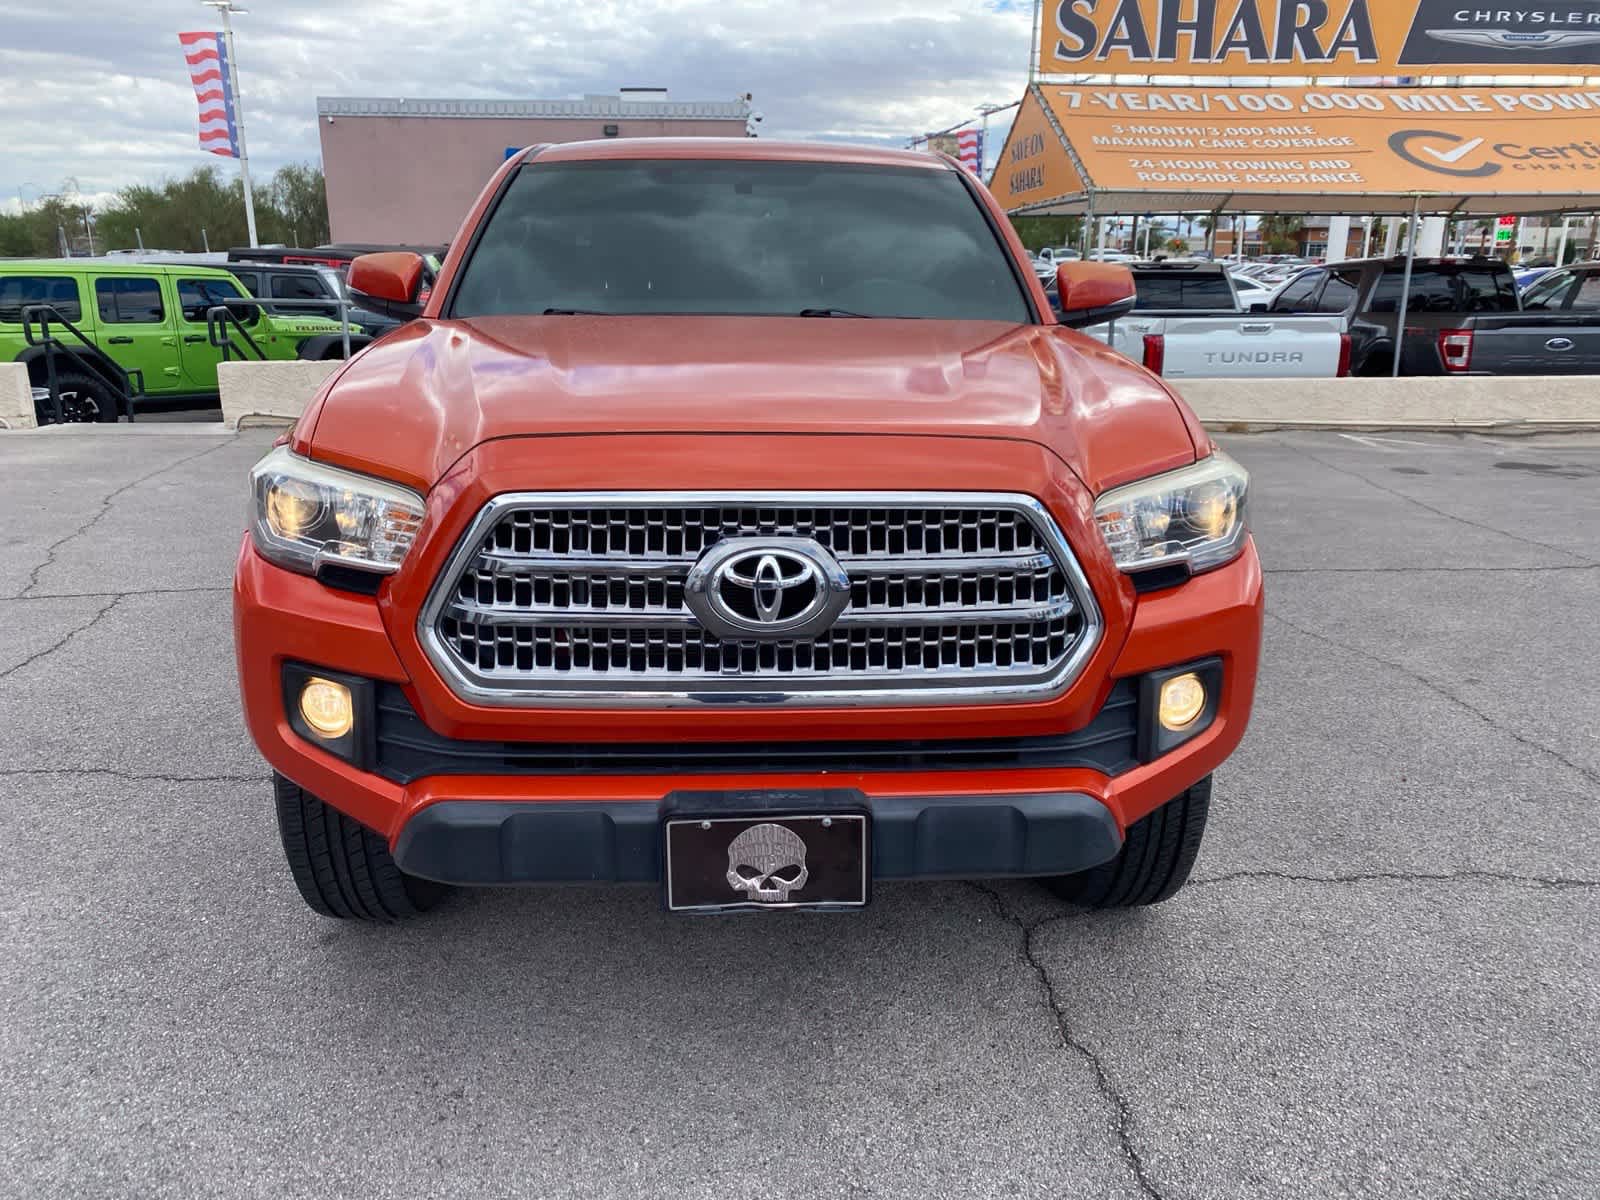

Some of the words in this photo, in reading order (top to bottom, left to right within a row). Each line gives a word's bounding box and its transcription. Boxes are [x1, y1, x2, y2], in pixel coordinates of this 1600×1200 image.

[1454, 10, 1600, 24] CHRYSLER
[1053, 0, 1380, 63] SAHARA
[1389, 94, 1494, 112] MILE
[1091, 135, 1195, 148] MAXIMUM
[1199, 138, 1249, 148] CARE
[1252, 136, 1355, 149] COVERAGE
[1128, 159, 1220, 169] 24-HOUR
[1222, 160, 1305, 170] TOWING
[1308, 159, 1352, 169] AND
[1136, 171, 1242, 183] ROADSIDE
[1244, 172, 1367, 183] ASSISTANCE
[1204, 351, 1304, 364] TUNDRA
